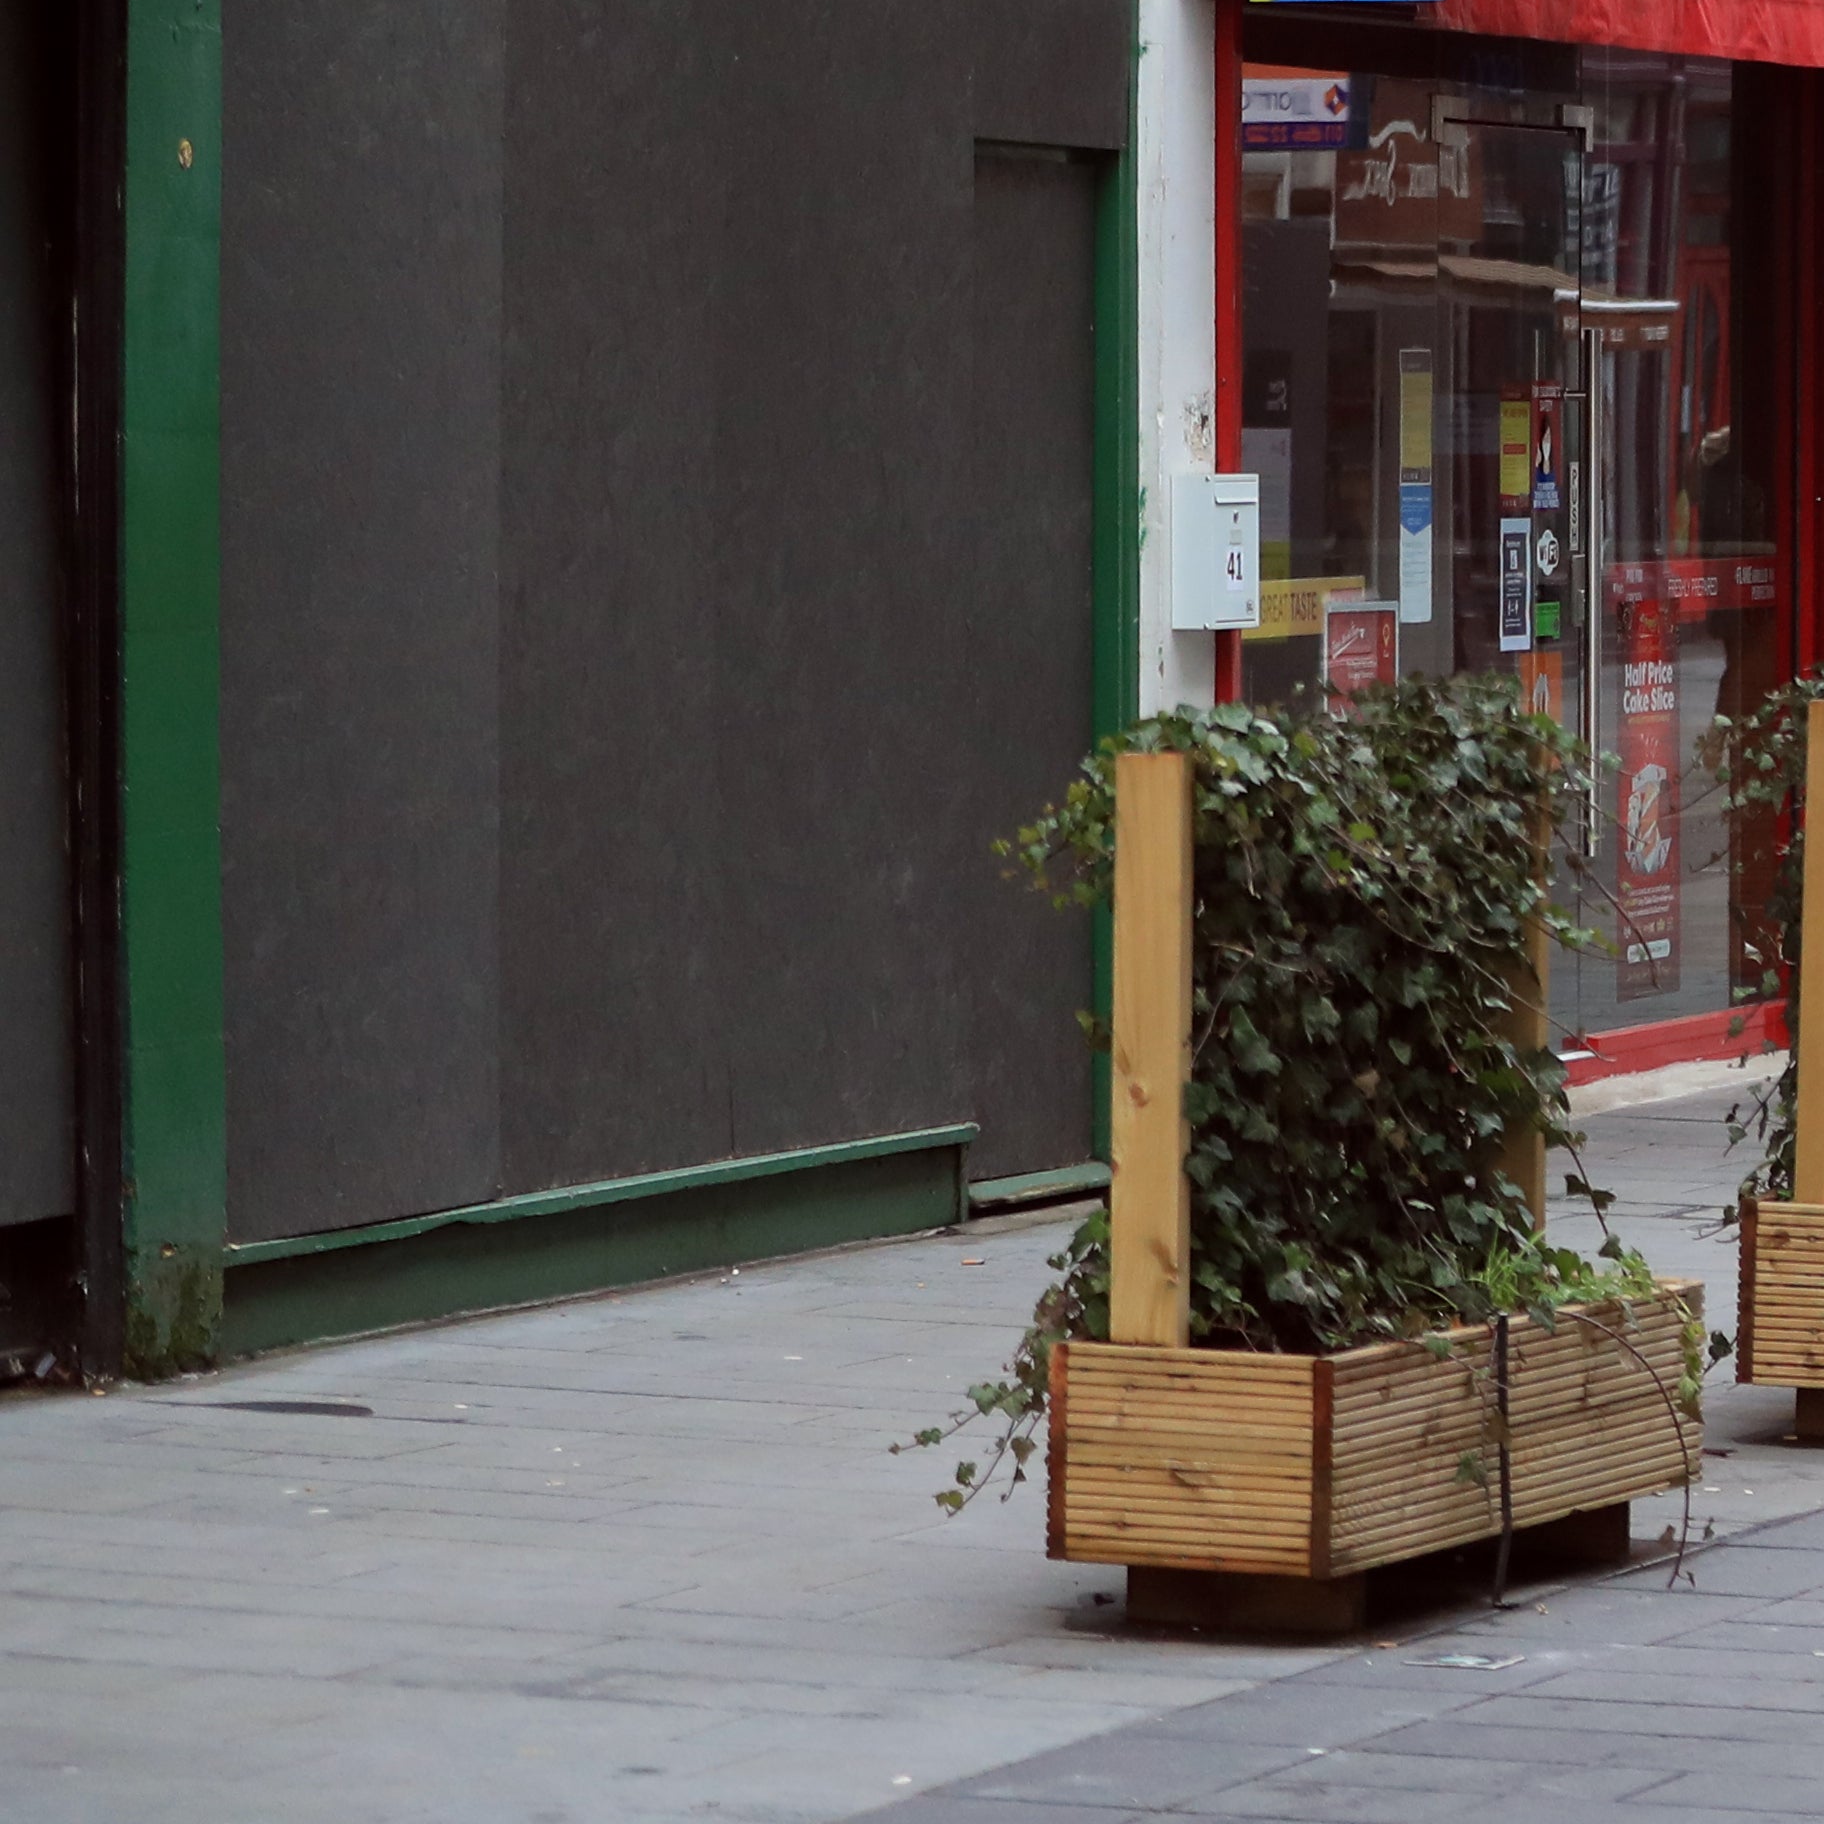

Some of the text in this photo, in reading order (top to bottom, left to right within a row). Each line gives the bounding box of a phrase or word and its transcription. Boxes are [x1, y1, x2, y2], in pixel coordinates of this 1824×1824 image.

[1227, 552, 1243, 580] 41
[1290, 592, 1317, 621] TASTE
[1625, 660, 1673, 687] Half Price
[1623, 686, 1675, 714] Cake Slice
